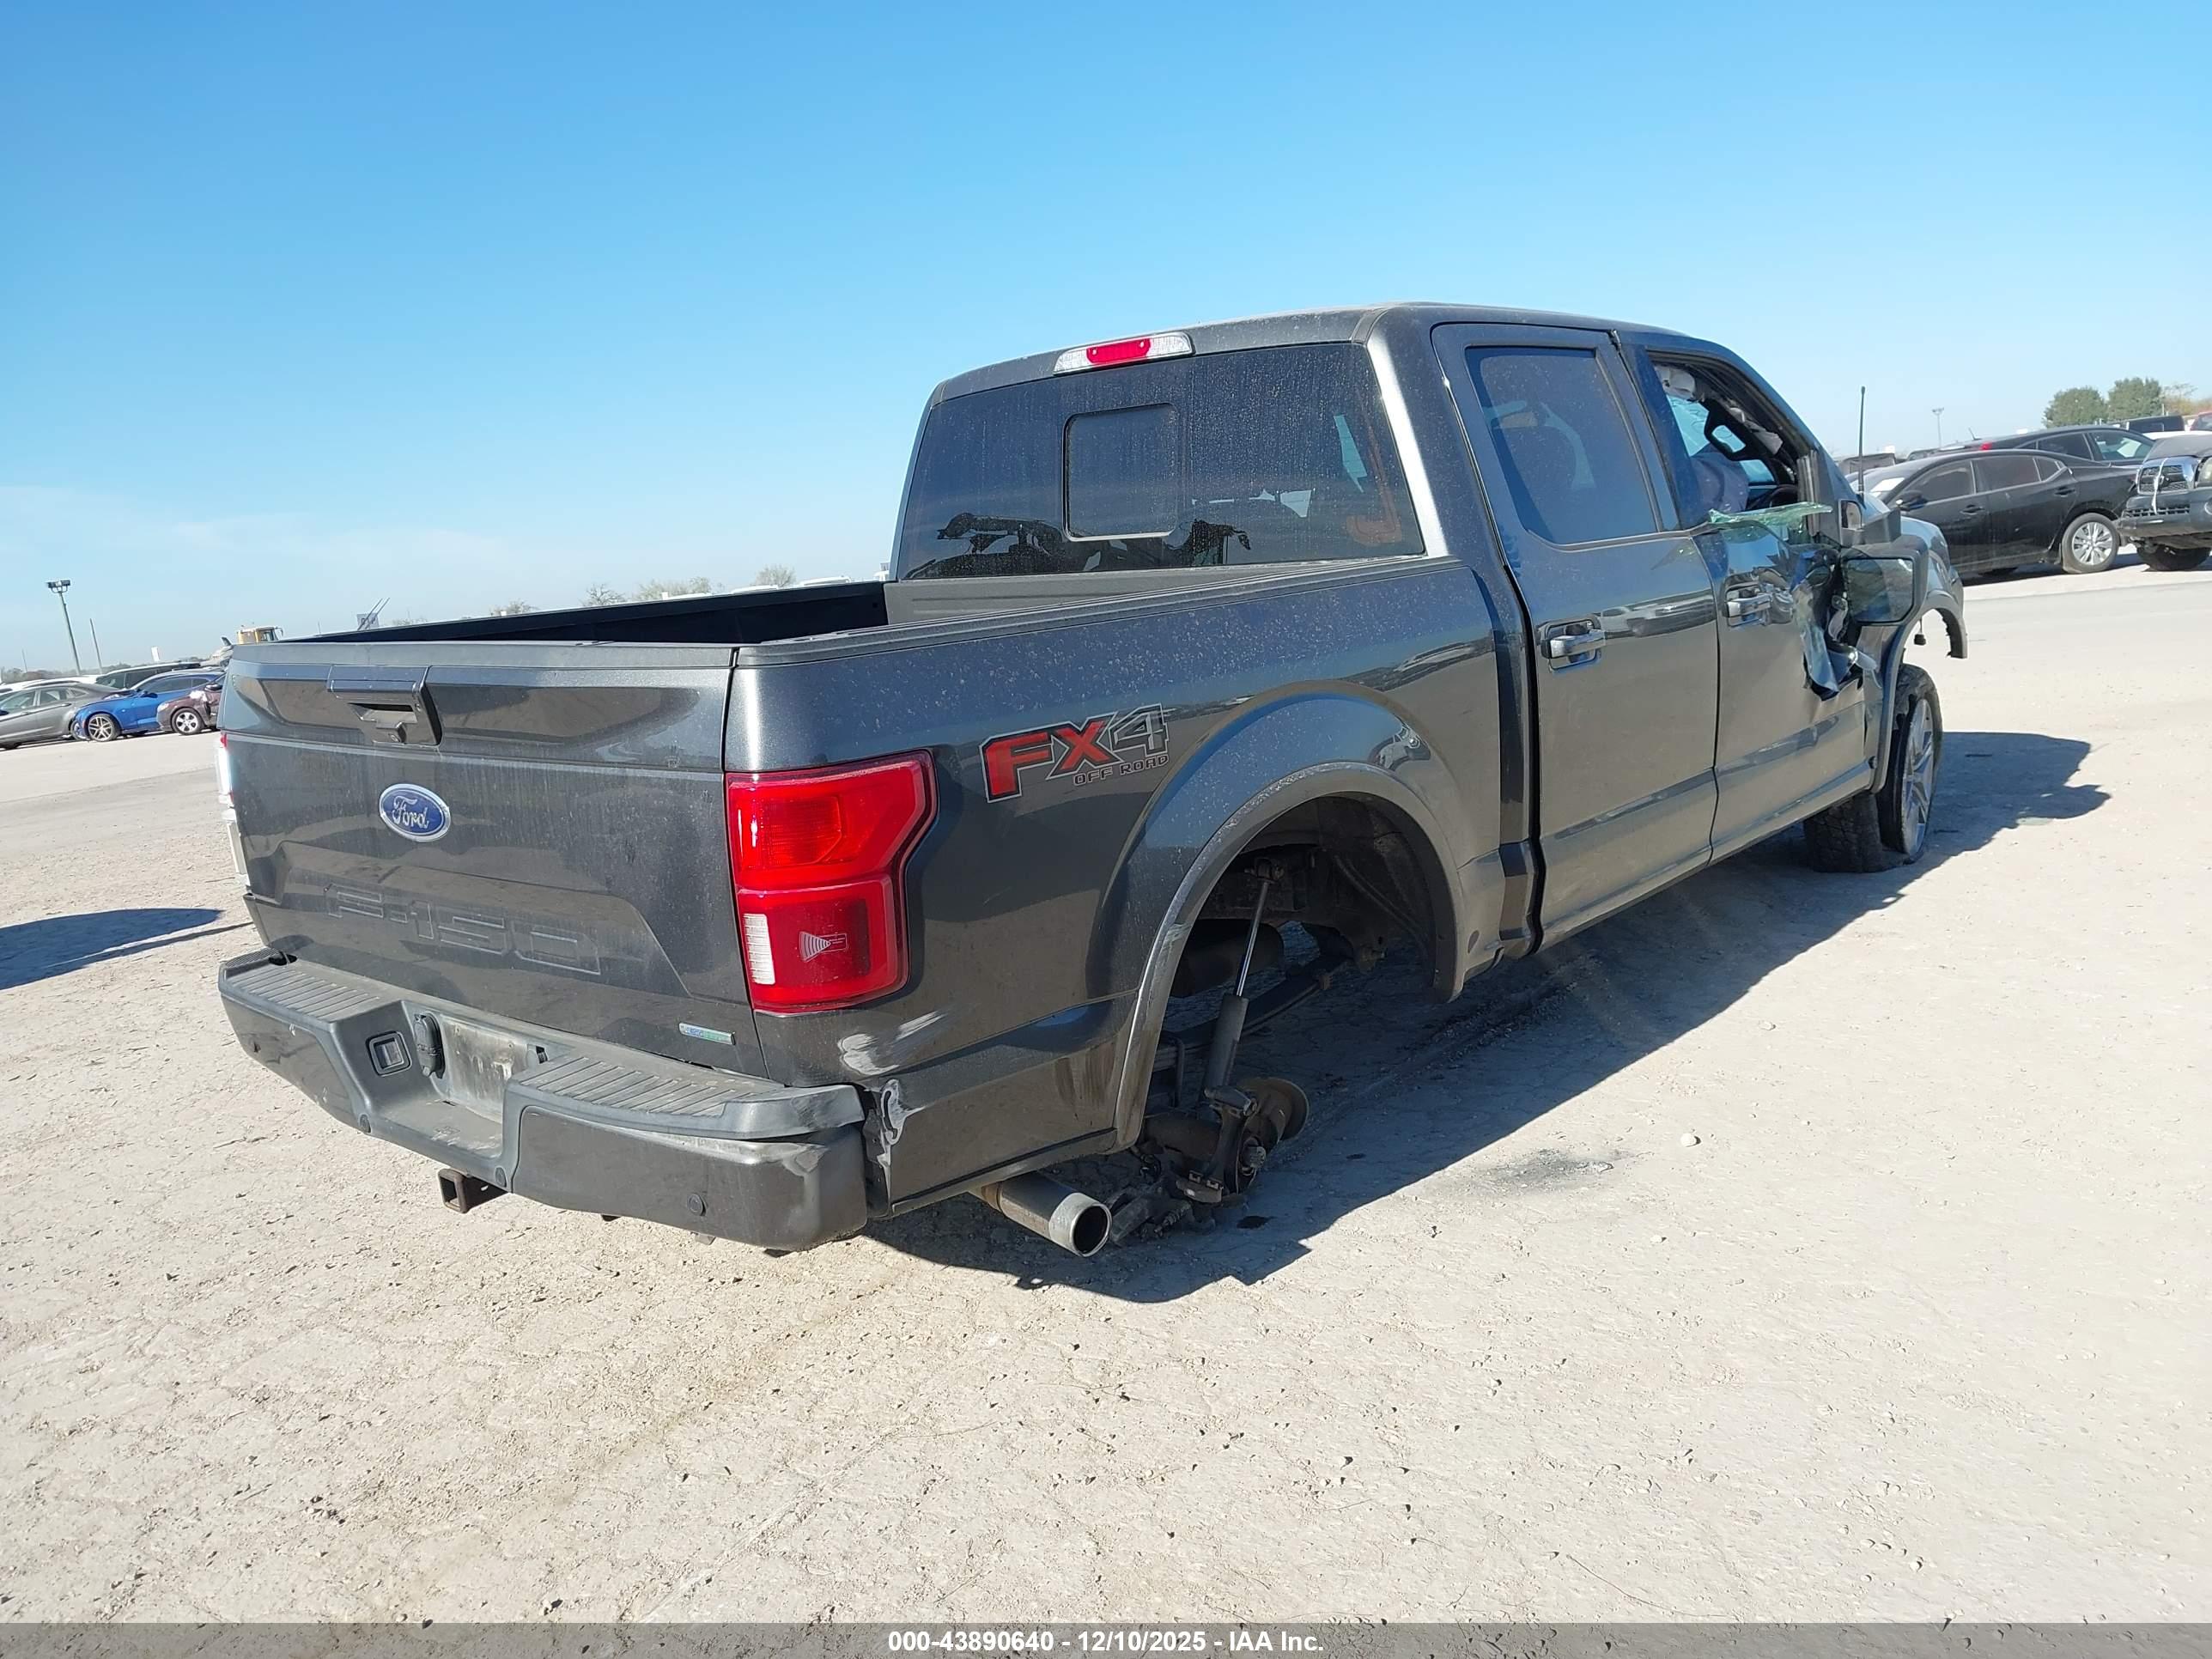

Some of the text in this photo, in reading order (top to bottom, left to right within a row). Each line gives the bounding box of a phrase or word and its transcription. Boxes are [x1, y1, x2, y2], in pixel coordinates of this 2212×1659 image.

[979, 702, 1169, 803] FX4
[1074, 754, 1169, 786] OFF ROAD
[392, 795, 429, 829] Ford
[324, 883, 600, 976] F-150
